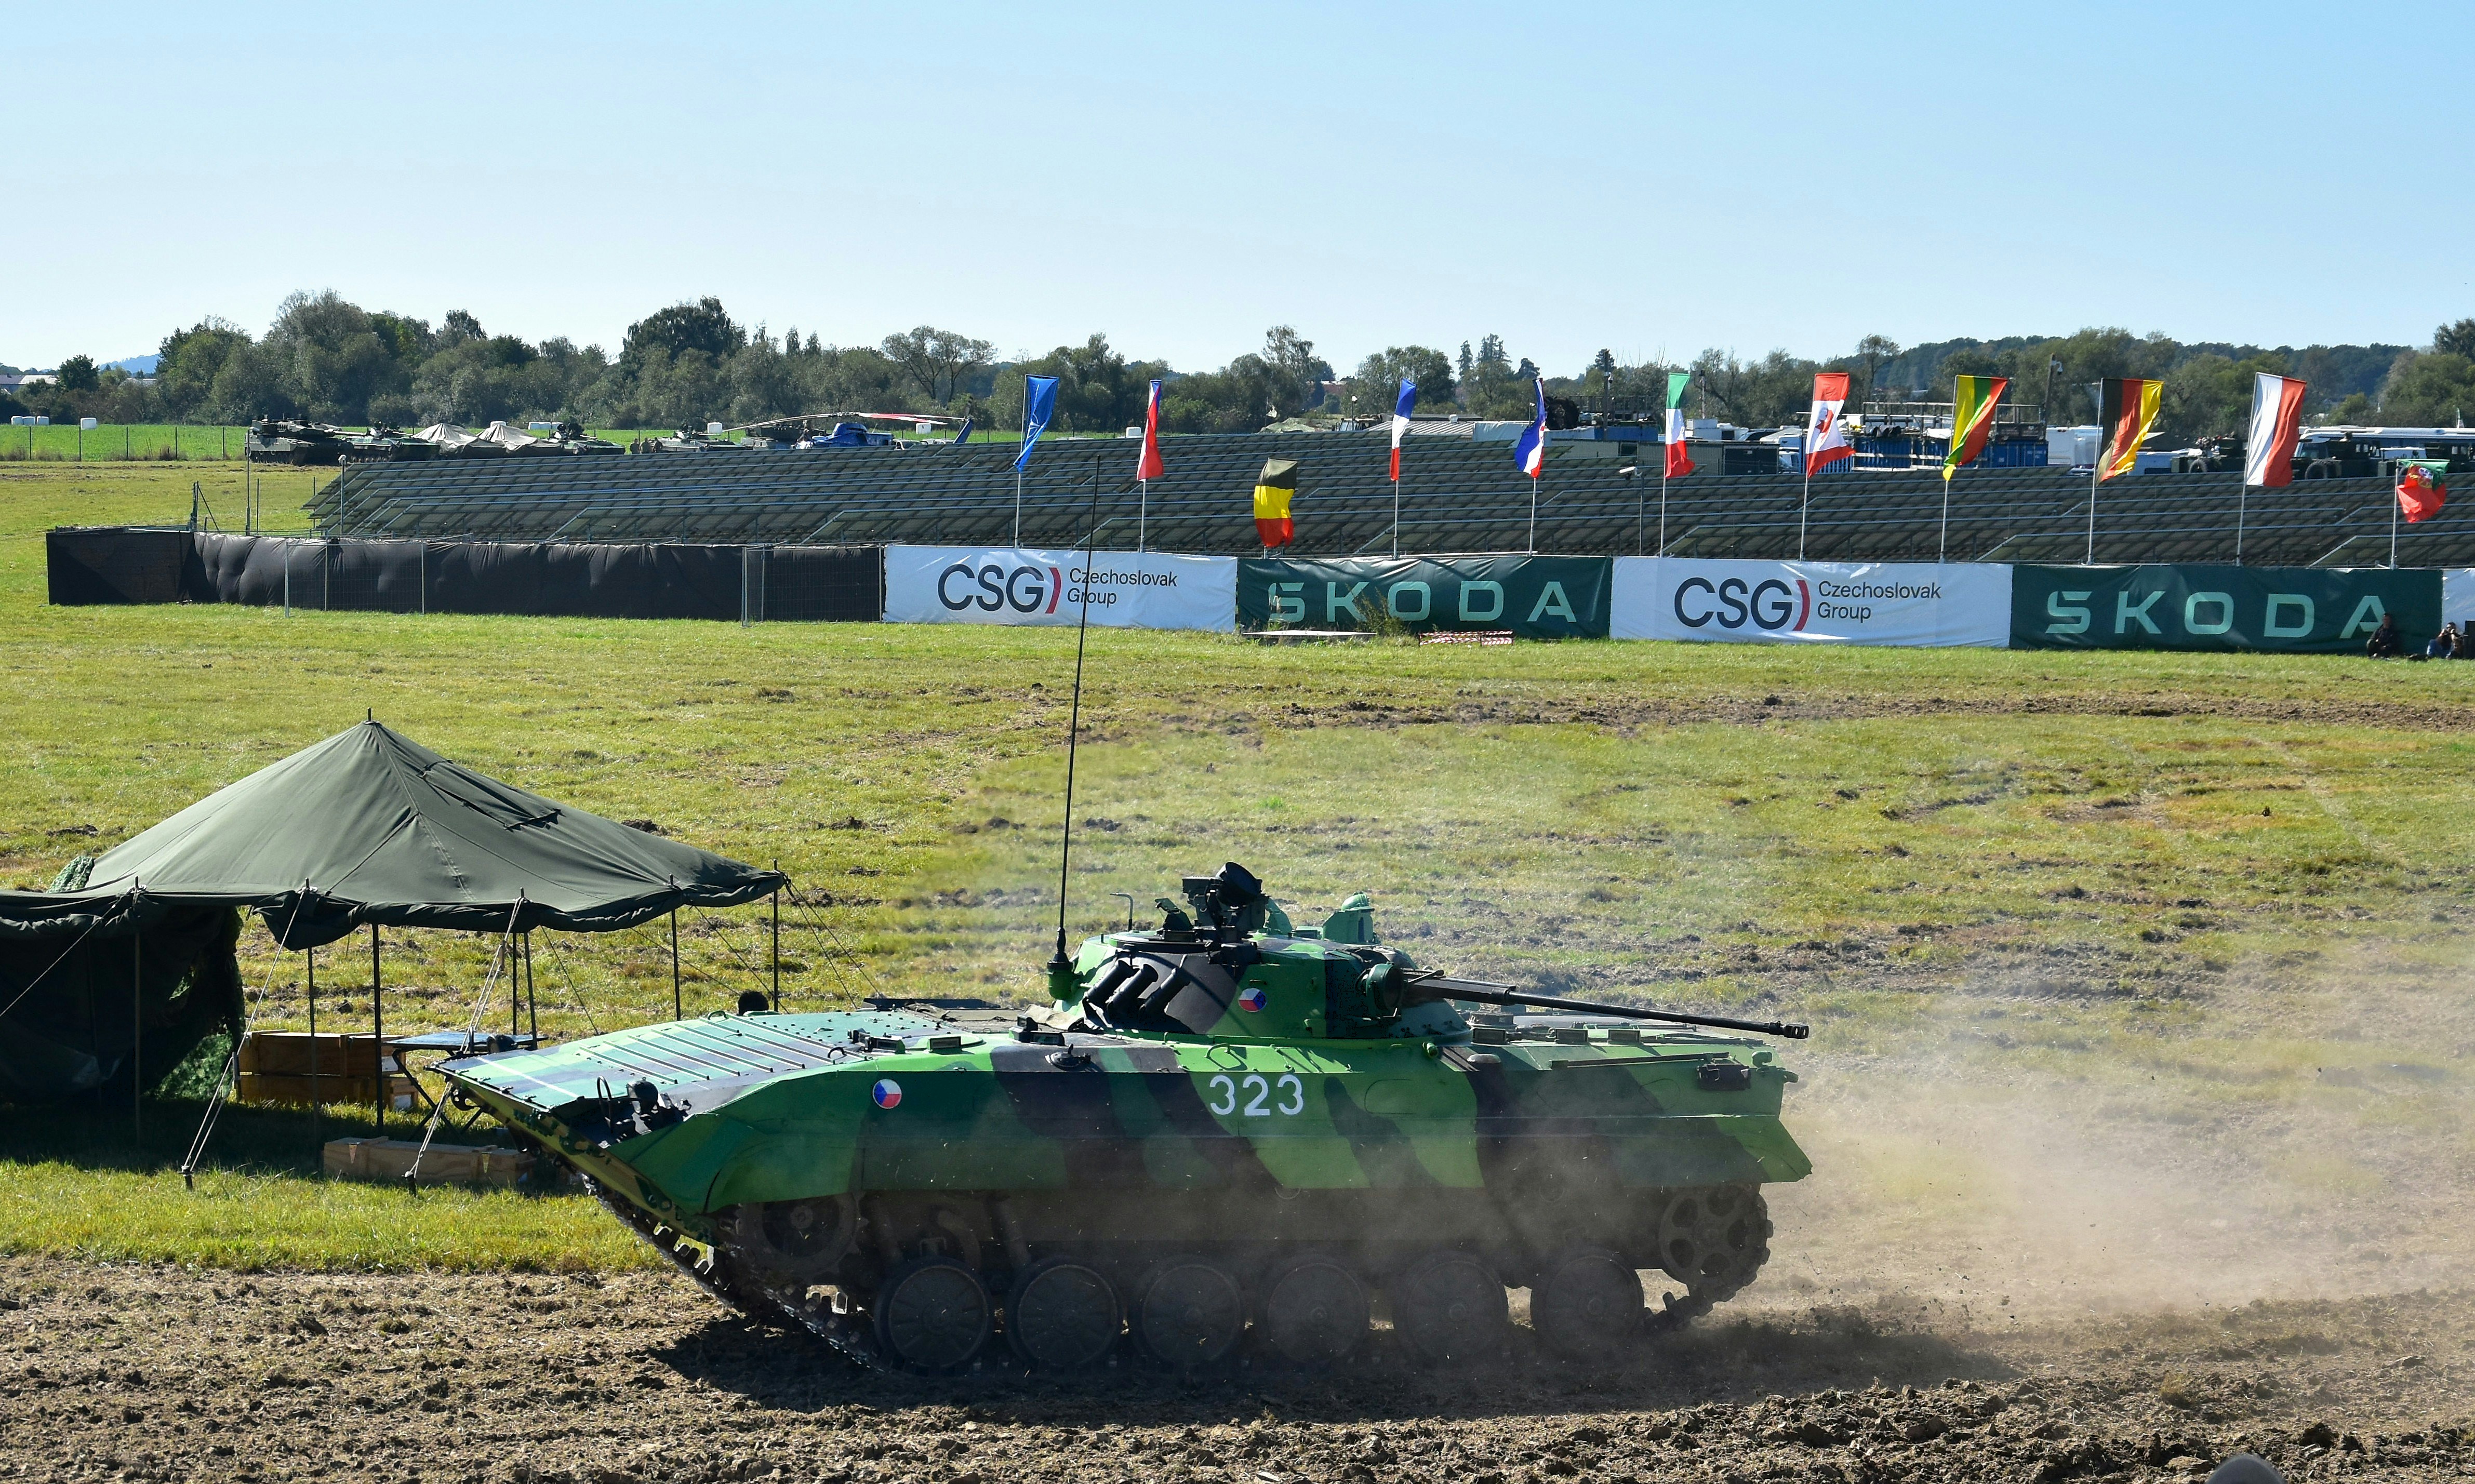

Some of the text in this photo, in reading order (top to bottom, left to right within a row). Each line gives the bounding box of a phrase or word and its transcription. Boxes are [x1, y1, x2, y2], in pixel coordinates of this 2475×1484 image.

[1069, 567, 1177, 586] Czechoslovak
[1067, 588, 1117, 607] Group
[1818, 580, 1941, 599] Czechoslovak
[1817, 603, 1871, 623] Group
[1209, 1075, 1303, 1116] 323
